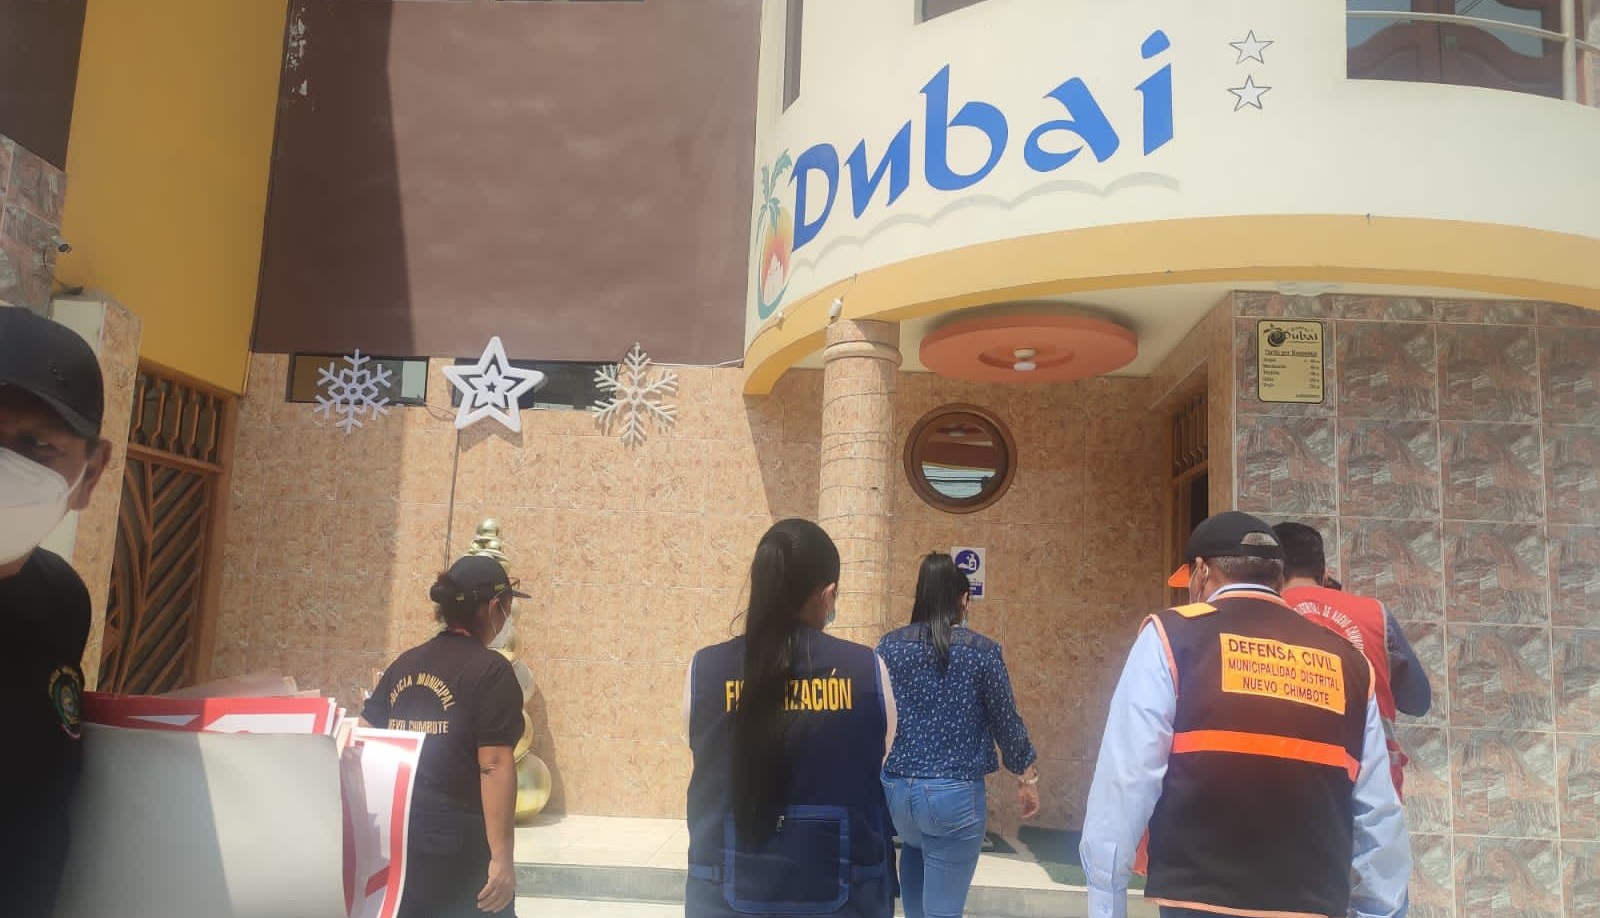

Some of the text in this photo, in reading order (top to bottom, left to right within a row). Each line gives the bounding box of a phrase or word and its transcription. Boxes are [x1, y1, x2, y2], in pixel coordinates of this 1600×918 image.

[788, 29, 1174, 253] Dubai
[1228, 638, 1337, 672] DEFENSA CIVIL
[416, 672, 456, 711] MUNICIPAL
[725, 667, 853, 712] FIIZACIÓN
[1228, 658, 1340, 691] MUNICIPALIDAD DISTRITAL
[1242, 677, 1329, 704] NUEVO CHIMBOTE
